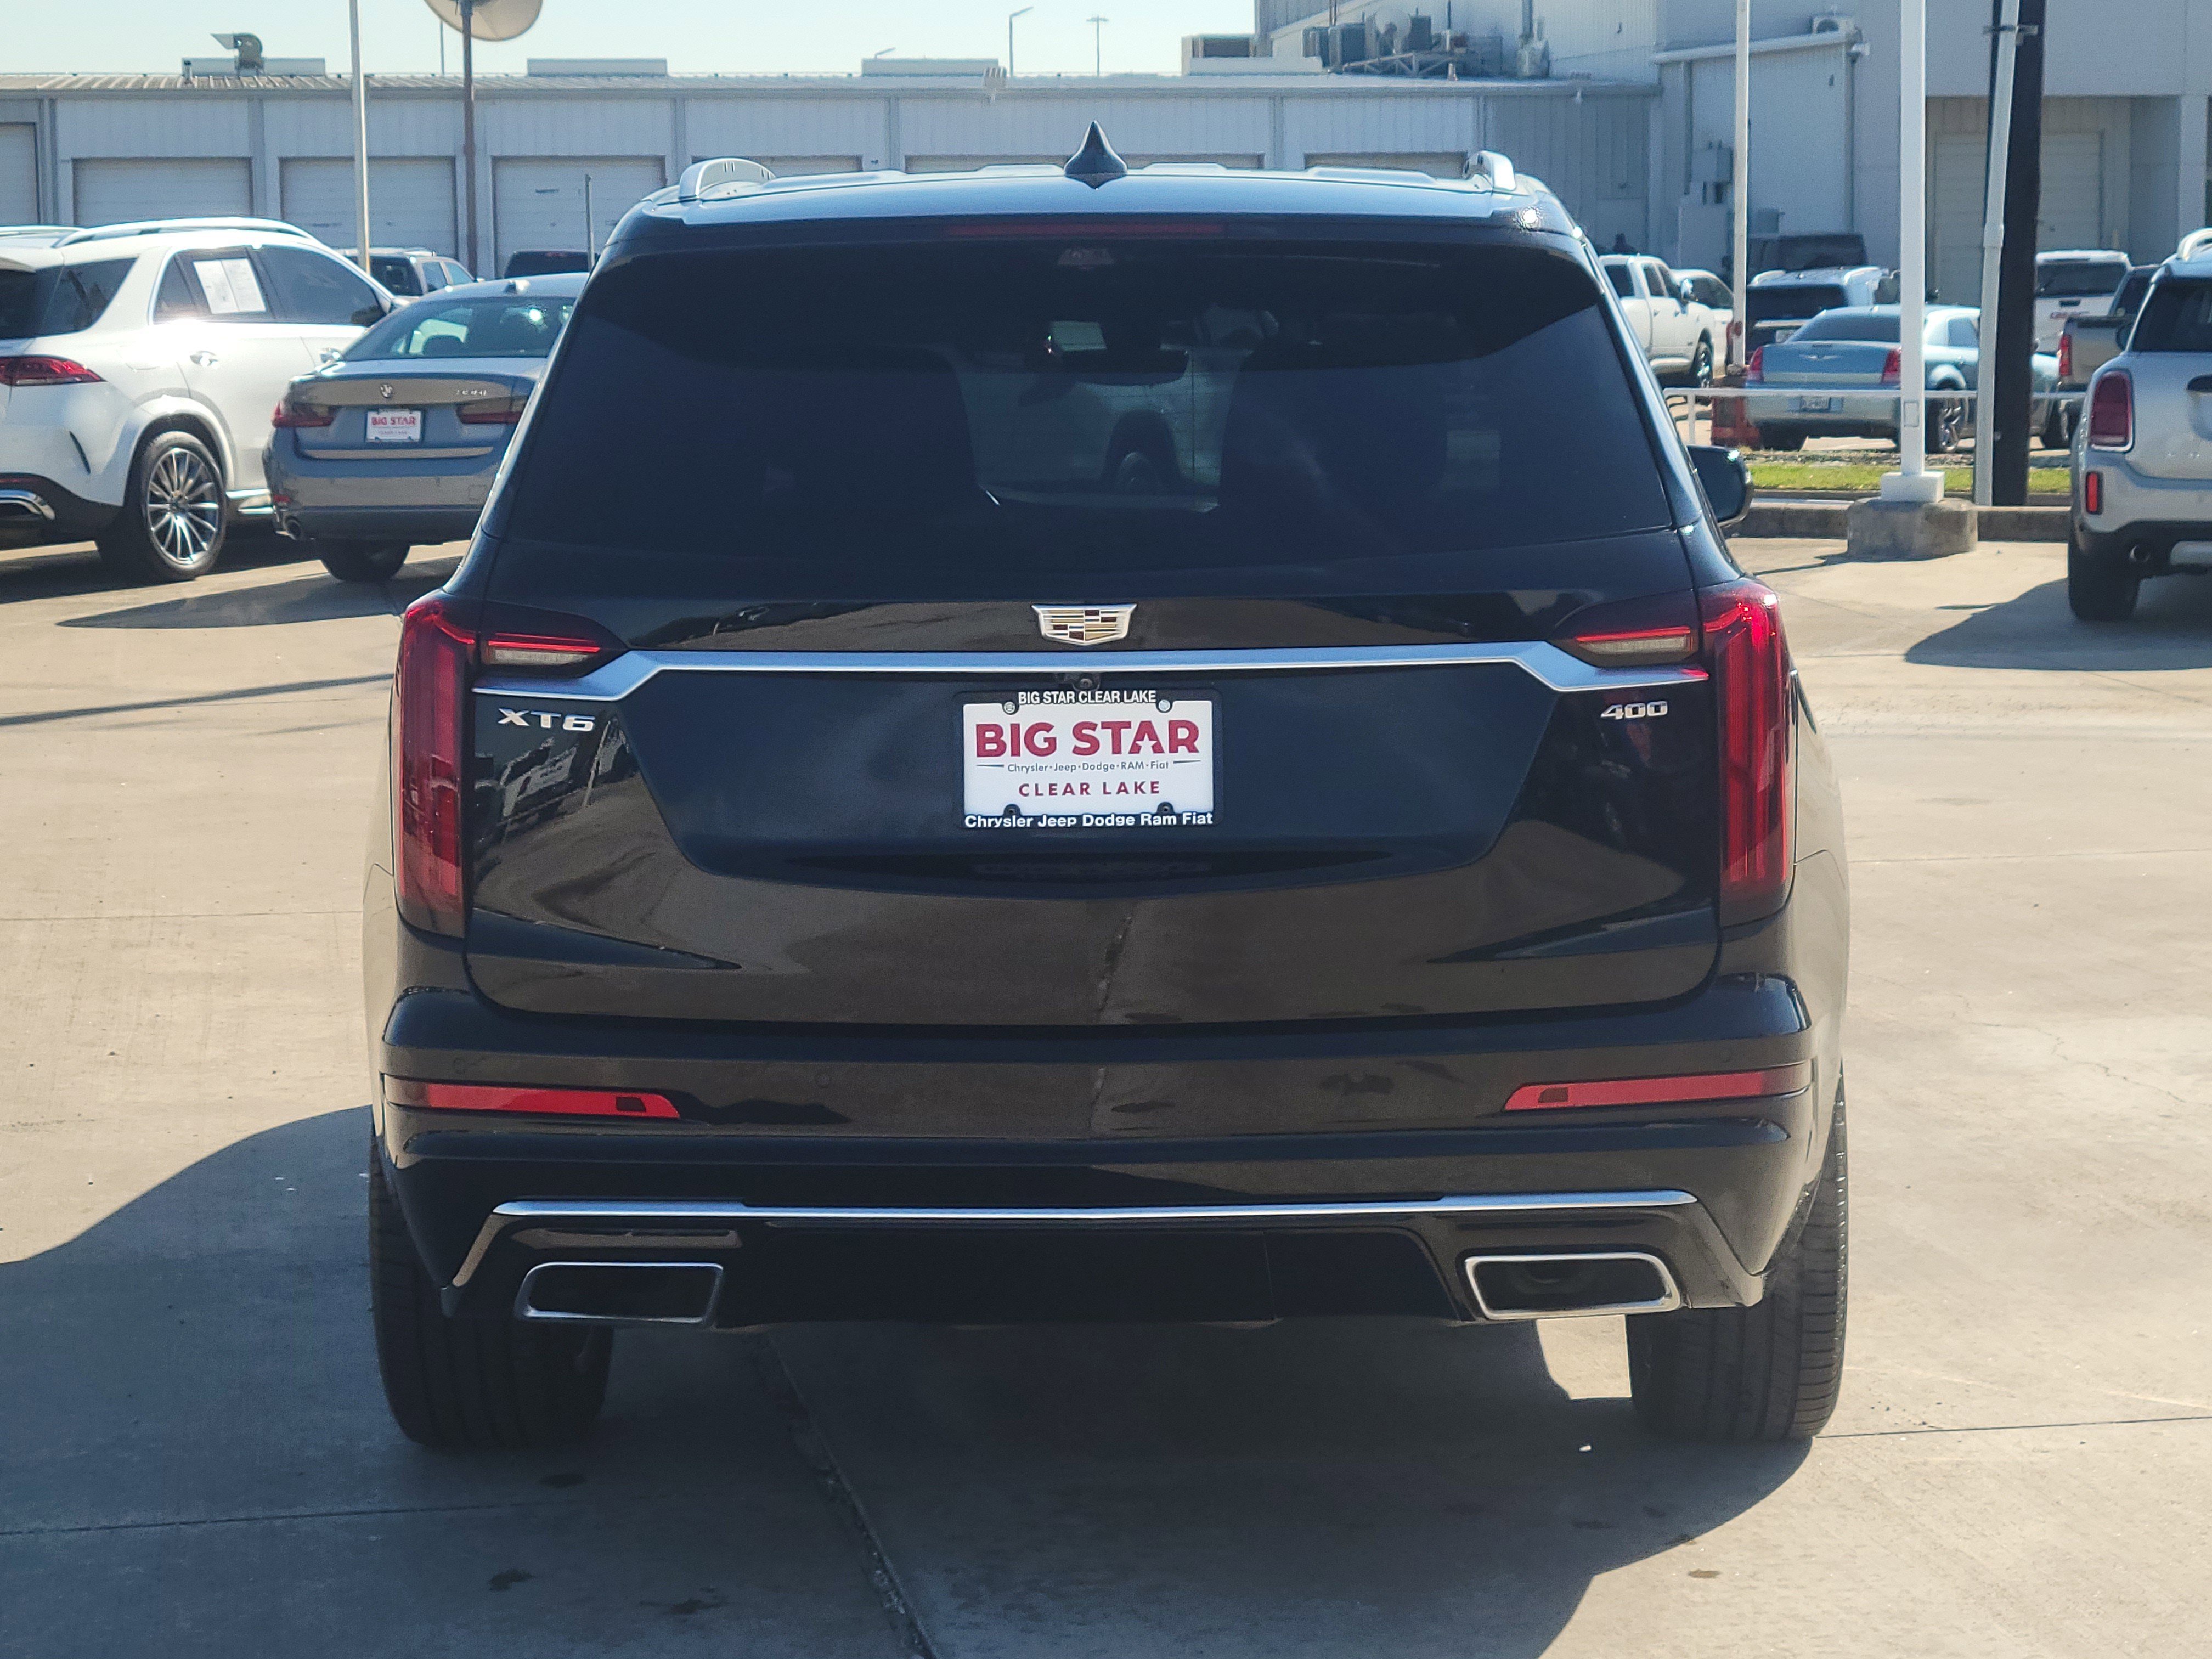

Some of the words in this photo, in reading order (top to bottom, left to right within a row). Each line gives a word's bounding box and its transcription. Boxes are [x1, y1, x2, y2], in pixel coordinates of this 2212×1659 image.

[391, 416, 416, 425] STAR
[1018, 691, 1040, 704] BIG
[1043, 691, 1075, 703] STAR
[1079, 690, 1120, 703] CLEAR
[1124, 690, 1156, 702] LAKE
[1601, 701, 1668, 719] 400
[498, 708, 595, 731] XT6
[976, 722, 1057, 757] BIG
[1072, 720, 1200, 756] STAR
[1019, 782, 1091, 797] CLEAR
[1102, 781, 1160, 795] LAKE
[964, 814, 1032, 828] Chrysler
[1037, 814, 1077, 828] Jeep
[1082, 814, 1135, 827] Dodge
[1141, 813, 1176, 826] Ram
[1182, 812, 1213, 825] Fiat
